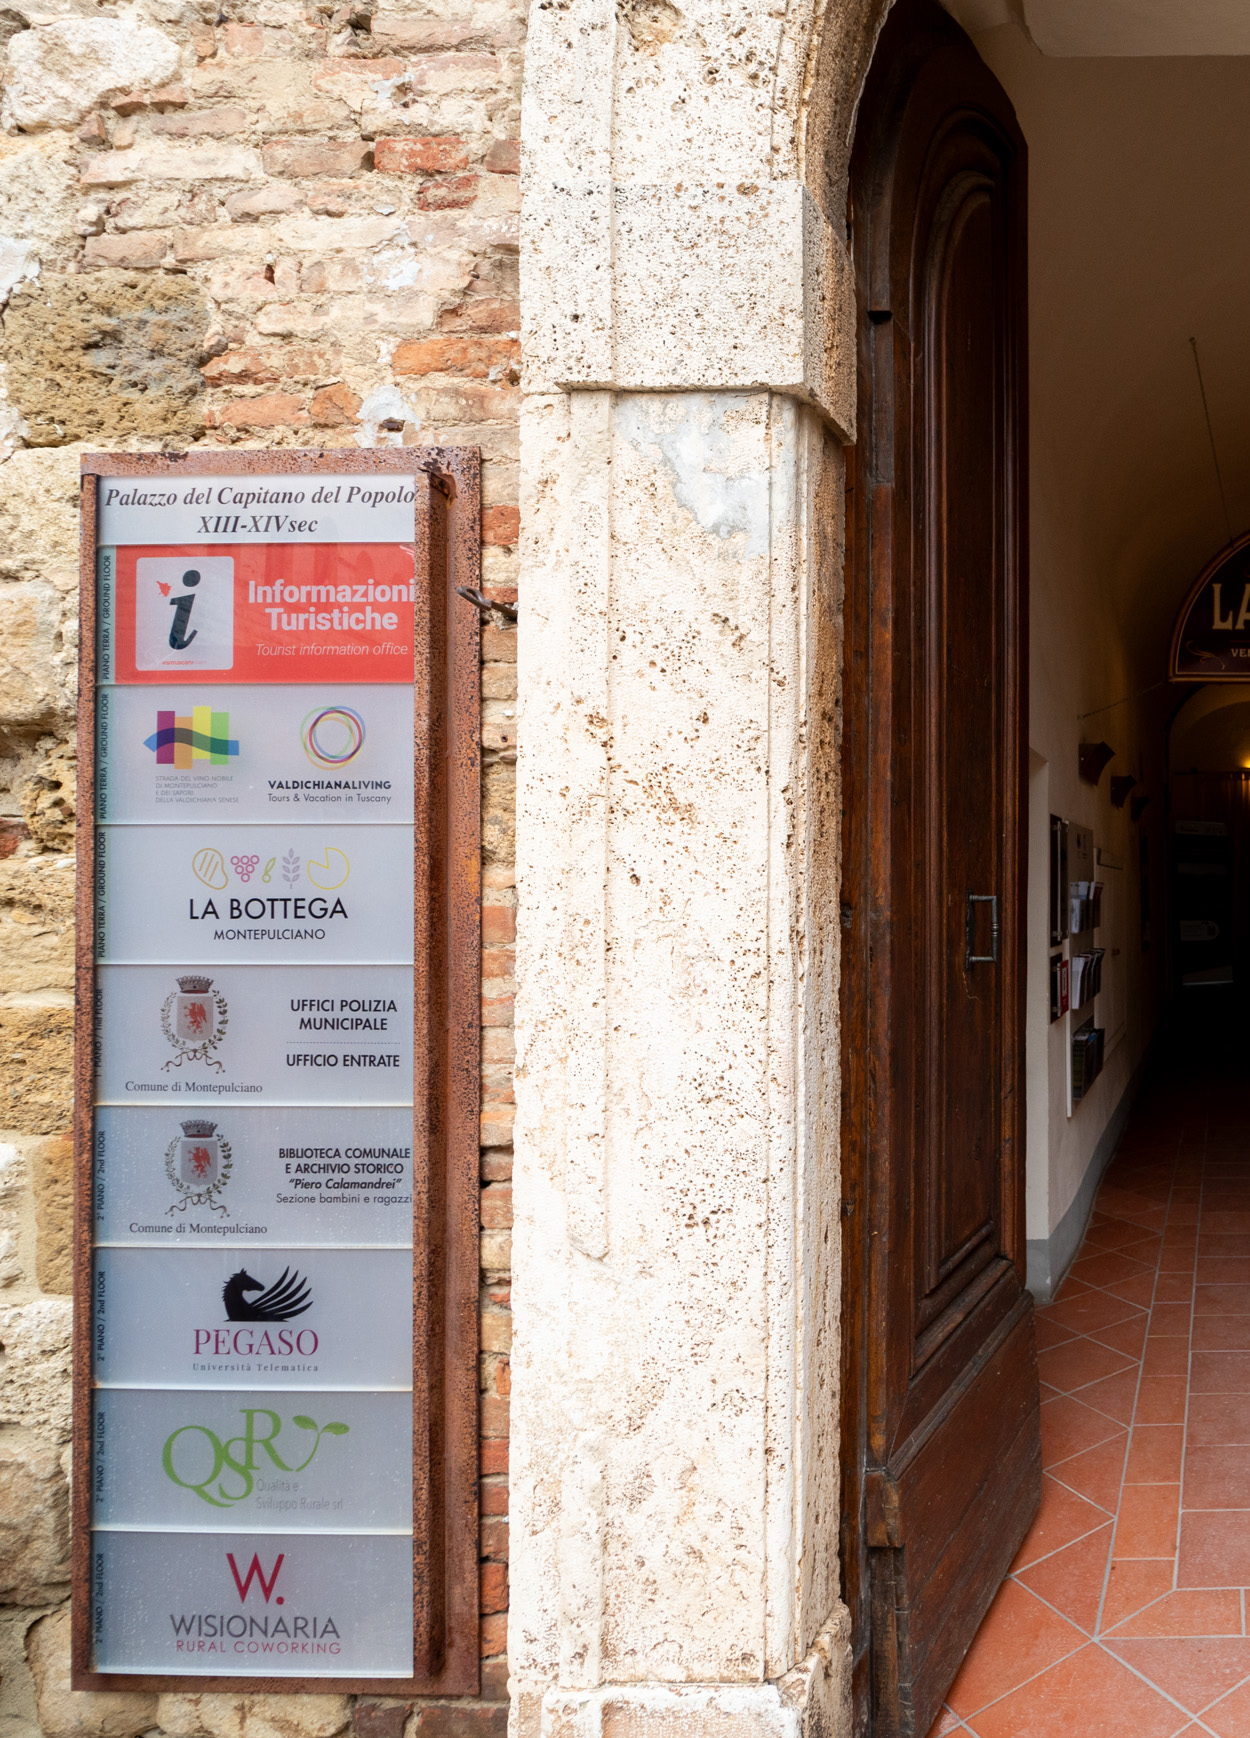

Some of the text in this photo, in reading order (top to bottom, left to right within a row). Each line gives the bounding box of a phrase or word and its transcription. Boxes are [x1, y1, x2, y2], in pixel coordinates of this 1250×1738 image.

[105, 486, 415, 509] Palazzo del Capitano del Popolo
[102, 555, 111, 581] FLOOR
[102, 583, 111, 619] GROUND
[248, 578, 415, 603] Informazioni
[265, 606, 398, 631] Turistiche
[102, 628, 111, 651] TERRA
[255, 641, 408, 656] Tourist information office
[102, 654, 111, 680] PIANO
[100, 694, 109, 720] FLOOR
[100, 721, 109, 758] GROUND
[100, 767, 109, 791] TERRA
[268, 780, 392, 790] VALDICHIANALIVING
[100, 793, 109, 819] PIANO
[268, 793, 392, 805] Tours & Vacation in Tuscany
[97, 832, 106, 858] FLOOR
[97, 860, 106, 896] GROUND
[97, 905, 106, 929] TERRA
[189, 897, 349, 920] LA BOTTEGA
[97, 931, 106, 958] PIANO
[213, 928, 326, 941] MONTEPULCIANO
[94, 988, 103, 1015] FLOOR
[290, 999, 398, 1013] UFFICI POLIZIA
[299, 1018, 388, 1031] MUNICIPALE
[94, 1041, 103, 1068] PIANO
[286, 1054, 400, 1068] UFFICIO ENTRATE
[125, 1081, 263, 1095] Comune di Montepulciano
[97, 1131, 106, 1157] FLOOR
[279, 1148, 411, 1159] BIBLIOTECA COMUNALE
[97, 1159, 106, 1174] 2nd
[285, 1163, 404, 1174] E ARCHIVIO STORICO
[289, 1177, 402, 1189] “Piero Calamandrei”
[97, 1183, 106, 1210] PIANO
[276, 1193, 316, 1203] Sezione
[320, 1193, 361, 1203] bambini
[373, 1193, 413, 1206] ragazzi
[129, 1222, 268, 1236] Comune di Montepulciano
[97, 1271, 106, 1298] FLOOR
[97, 1299, 106, 1315] 2nd
[97, 1324, 106, 1350] PIANO
[193, 1329, 319, 1356] PEGASO
[192, 1363, 319, 1372] Università Telematica
[96, 1412, 105, 1439] FLOOR
[96, 1440, 105, 1456] 2nd
[96, 1465, 105, 1492] PIANO
[293, 1482, 299, 1492] e
[256, 1496, 343, 1511] Sviluppo Rurale srl
[95, 1553, 104, 1580] FLOOR
[226, 1552, 285, 1606] W.
[95, 1606, 104, 1633] PIANO
[170, 1614, 341, 1639] WISIONARIA
[176, 1640, 342, 1655] RURAL COWORKING
